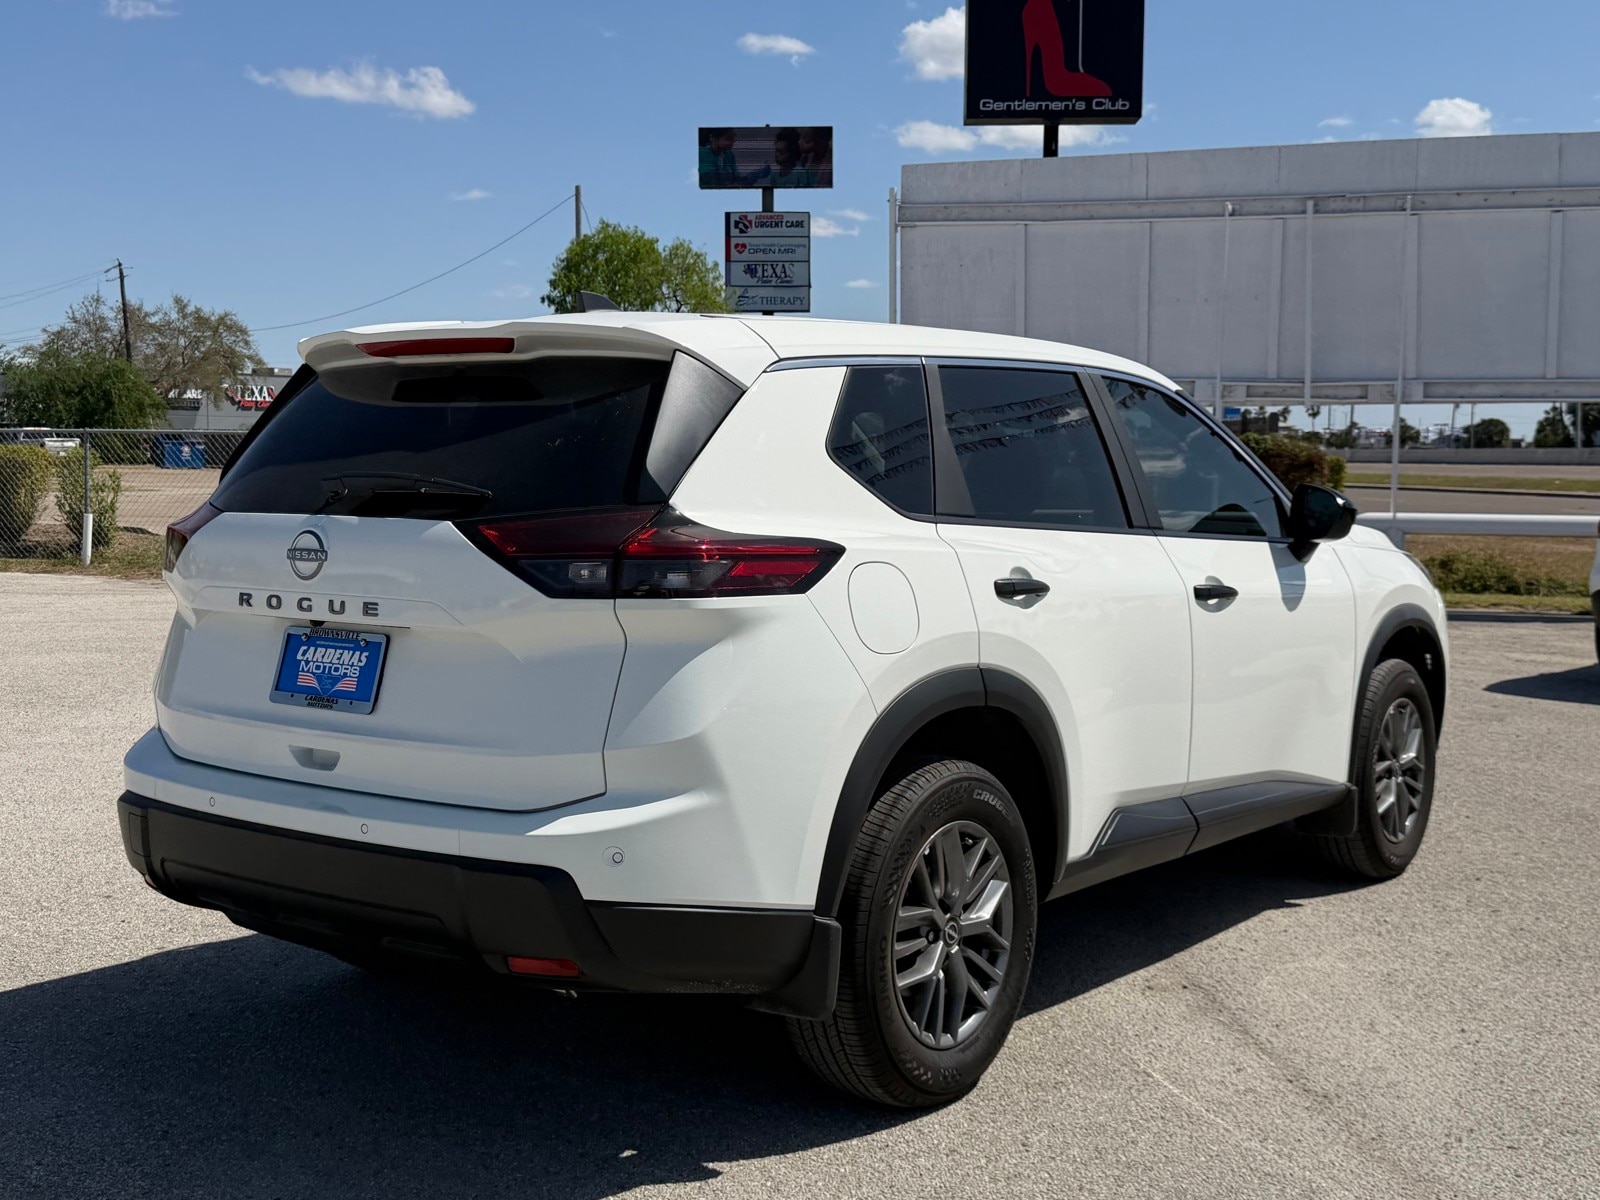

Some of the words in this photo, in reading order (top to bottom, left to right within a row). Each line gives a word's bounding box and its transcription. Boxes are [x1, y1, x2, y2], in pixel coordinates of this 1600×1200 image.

[979, 98, 1086, 111] Gentlemen's
[1092, 97, 1130, 110] Club
[754, 220, 784, 228] URGENT
[785, 220, 805, 228] CARE
[753, 263, 795, 279] TEXAS
[759, 296, 805, 305] THERAPY
[287, 550, 326, 560] NISSAN
[238, 592, 380, 617] ROGUE
[308, 628, 361, 641] BROWNSVILLE
[296, 646, 369, 667] CARDENAS
[299, 660, 360, 677] MOTORS
[304, 695, 339, 705] CARDENAS
[306, 701, 334, 710] MOTORS
